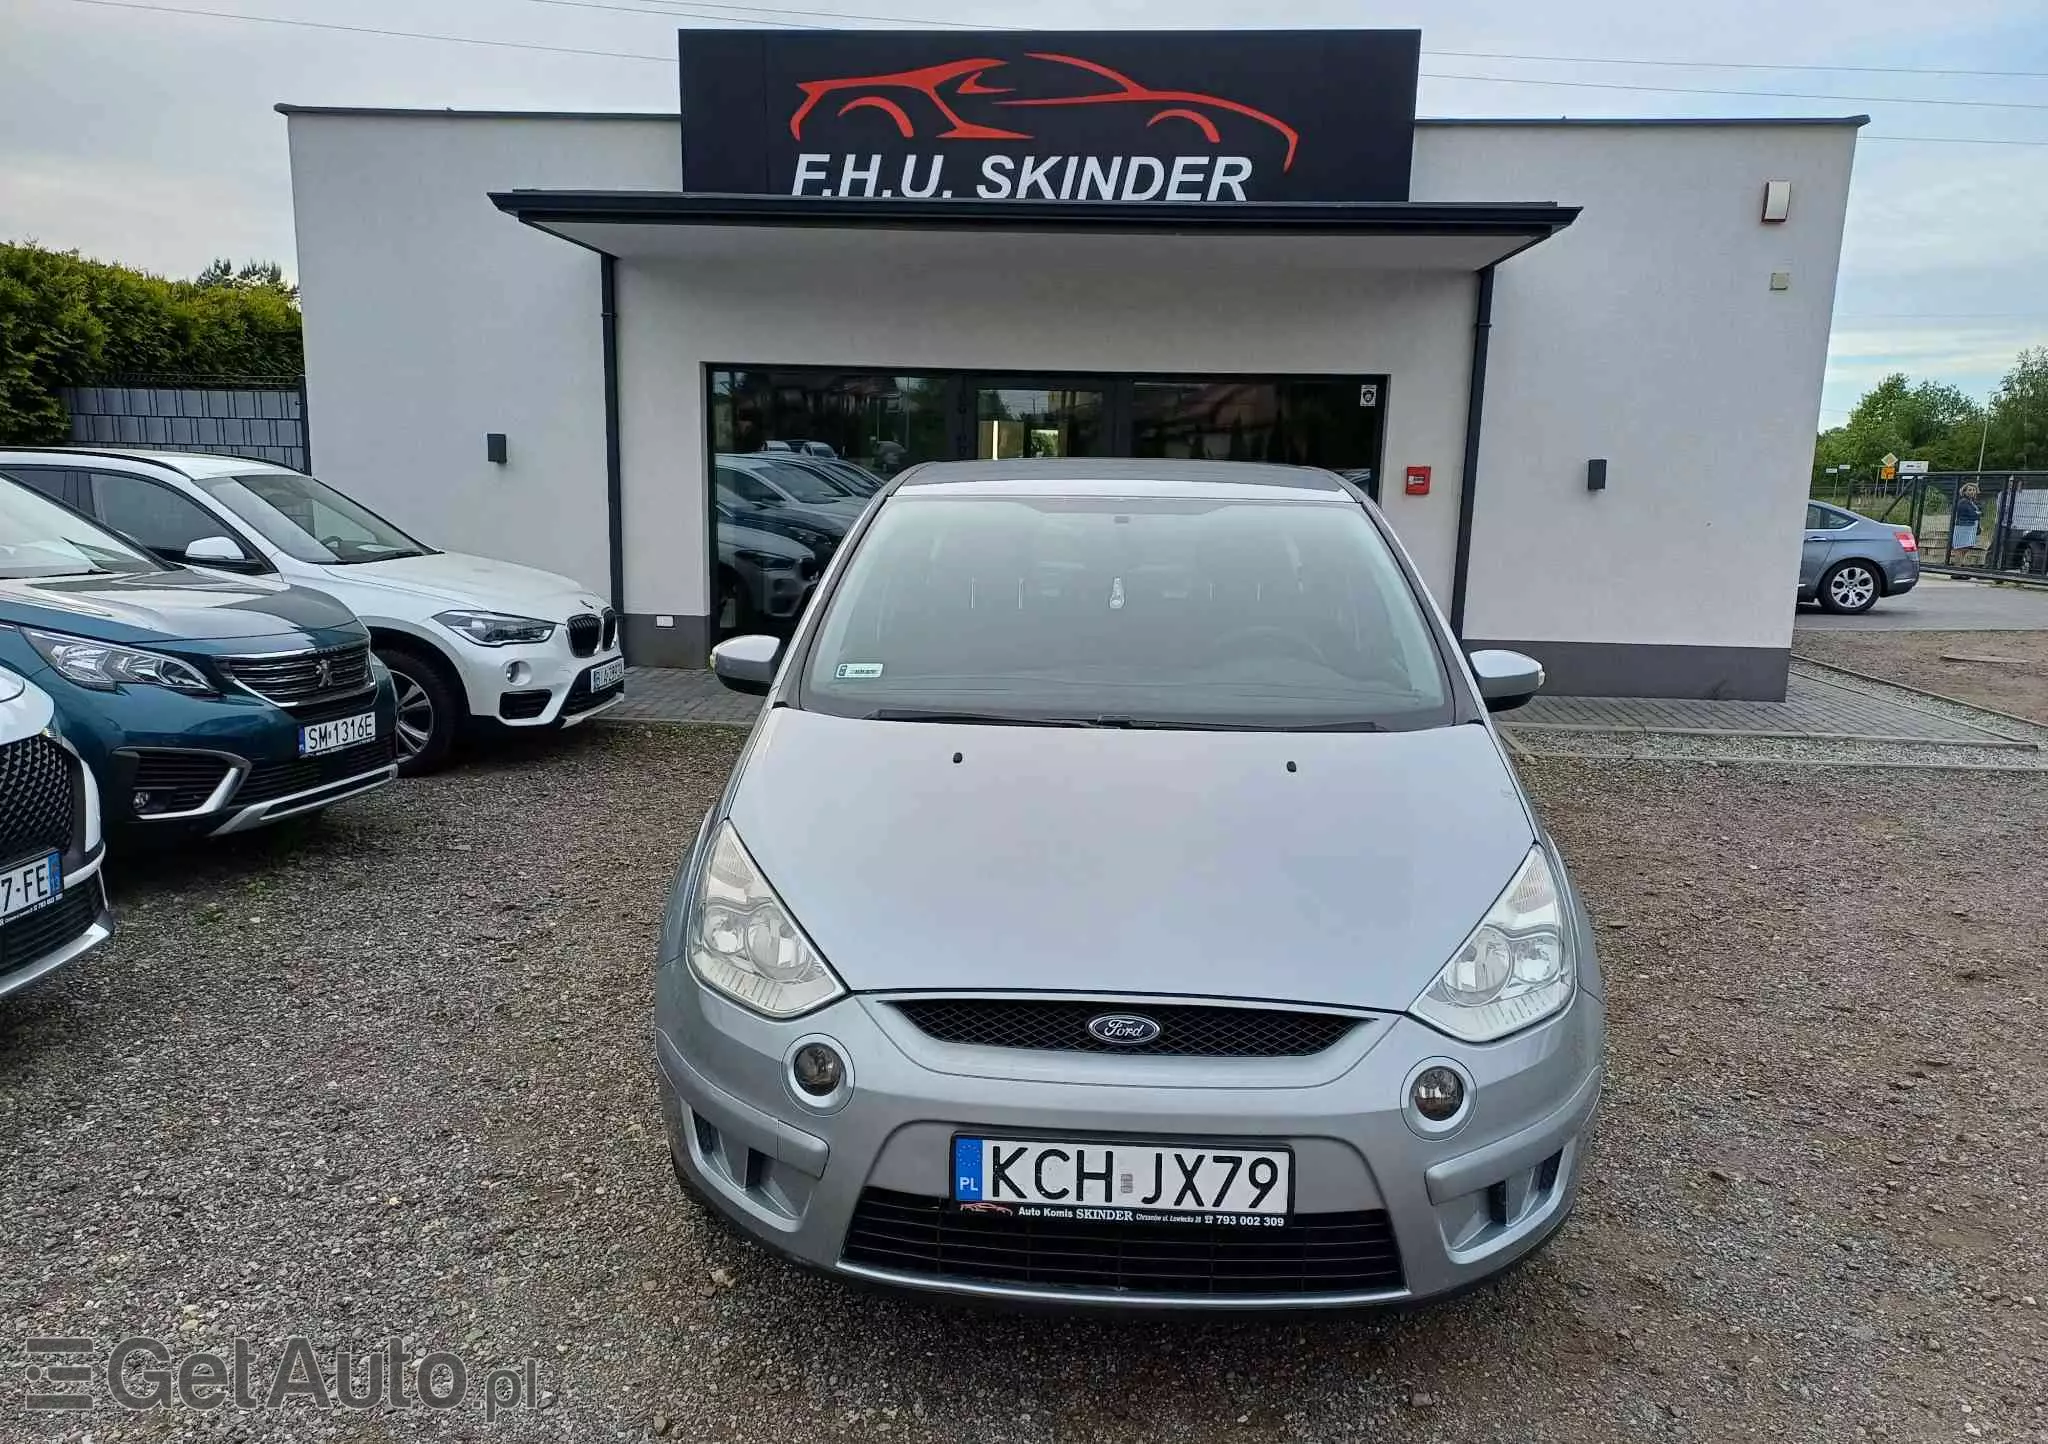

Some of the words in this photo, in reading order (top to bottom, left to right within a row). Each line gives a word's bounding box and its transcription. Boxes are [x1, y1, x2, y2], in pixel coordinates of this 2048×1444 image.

[791, 154, 953, 199] F.H.U.
[975, 156, 1254, 202] SKINDER
[309, 725, 328, 750] SM
[334, 714, 372, 745] 1316E
[1104, 1019, 1145, 1038] Ford
[959, 1176, 979, 1192] PL
[992, 1146, 1114, 1203] KCH
[1141, 1153, 1279, 1209] JX79
[1018, 1206, 1041, 1217] Auto
[1043, 1207, 1073, 1219] Komis
[1076, 1208, 1134, 1222] SKINDER
[1216, 1215, 1237, 1225] 793
[1239, 1216, 1261, 1226] 002
[1263, 1217, 1285, 1227] 309
